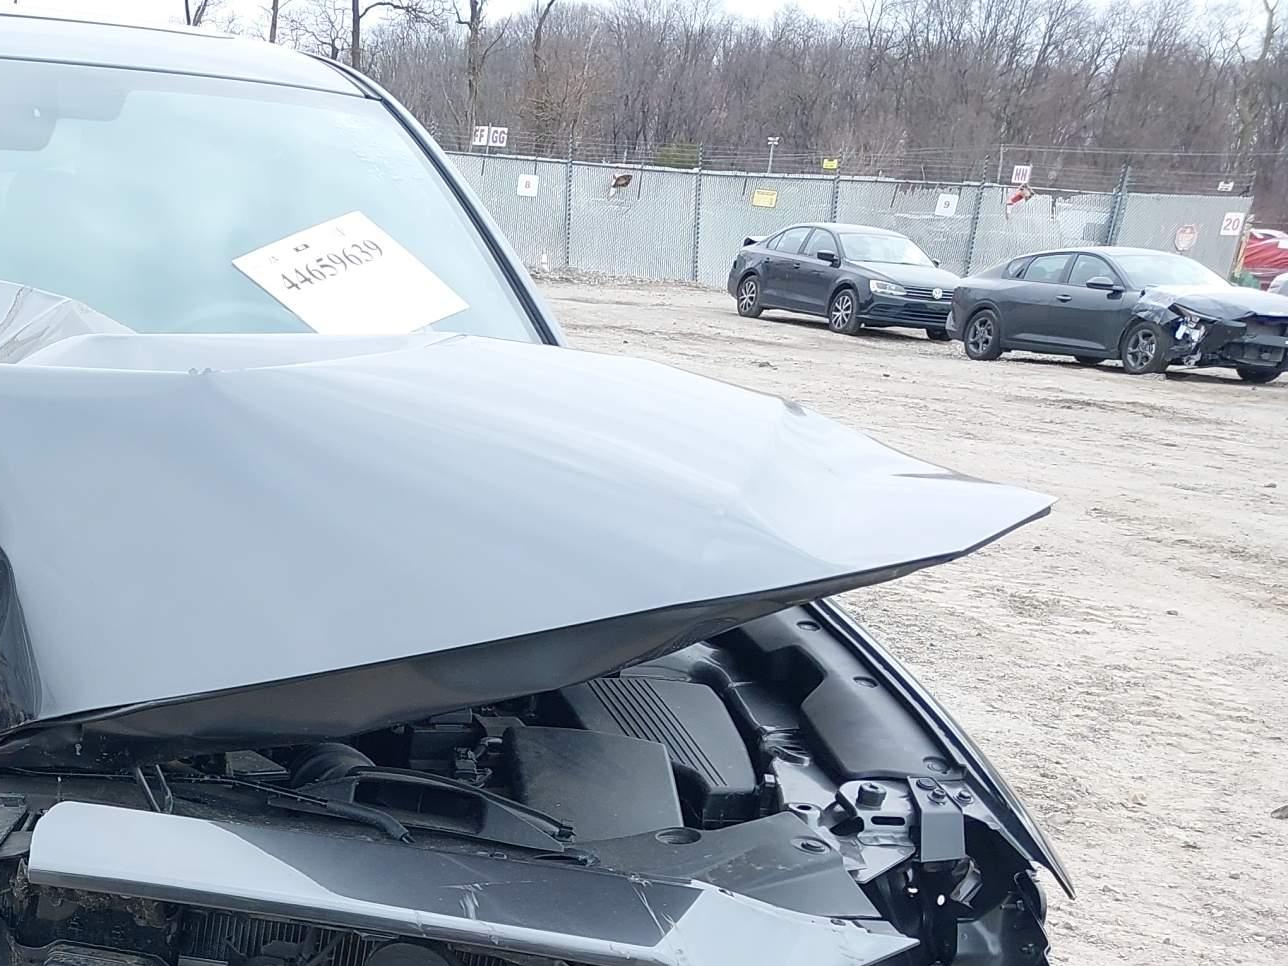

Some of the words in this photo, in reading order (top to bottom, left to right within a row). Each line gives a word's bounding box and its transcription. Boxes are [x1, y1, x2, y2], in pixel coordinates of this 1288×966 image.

[473, 128, 485, 143] FF
[492, 130, 505, 144] GG
[1015, 167, 1029, 181] HH
[1223, 218, 1241, 231] 20
[281, 239, 384, 291] 44659639
